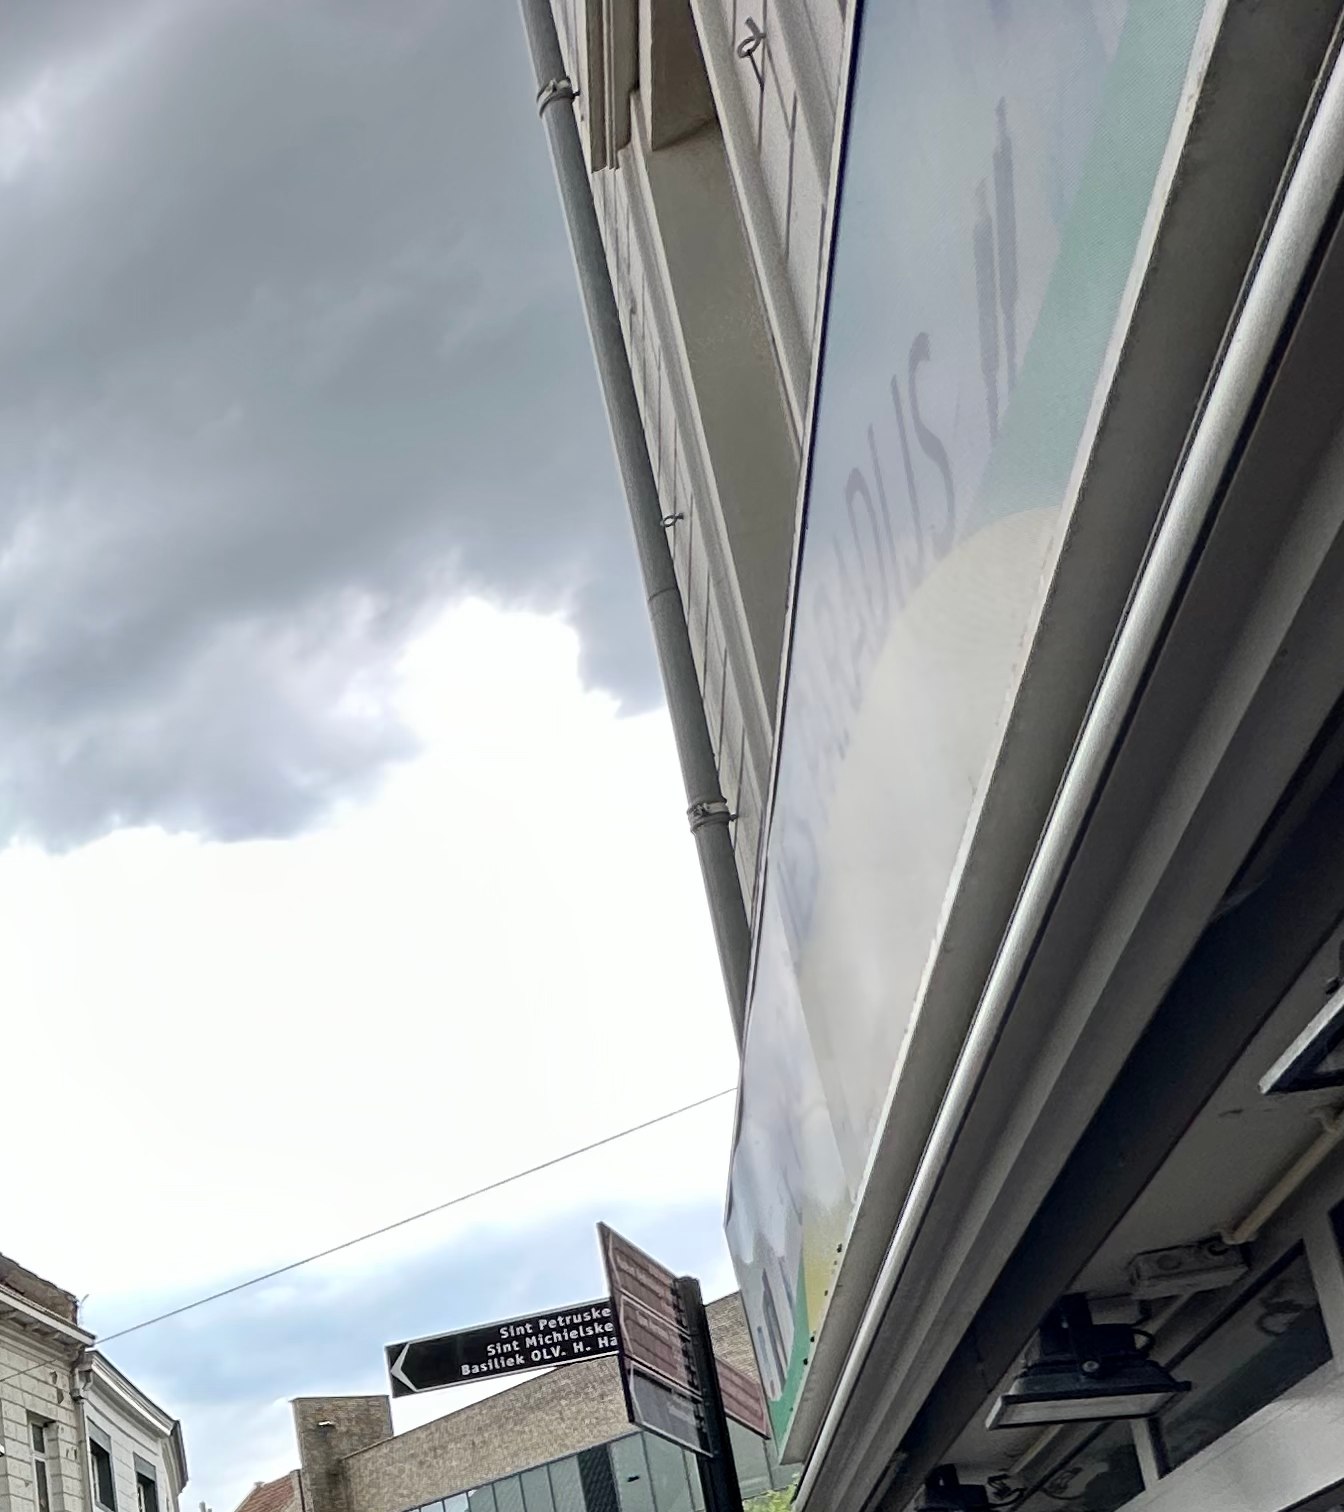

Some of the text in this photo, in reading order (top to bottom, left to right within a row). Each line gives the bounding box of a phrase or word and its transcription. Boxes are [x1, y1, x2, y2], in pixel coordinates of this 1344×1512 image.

[486, 1321, 614, 1357] Sint Michielske
[499, 1306, 612, 1339] Sint Petruske
[461, 1354, 524, 1376] Basiliek
[531, 1345, 566, 1362] OLV.
[573, 1341, 592, 1354] H.
